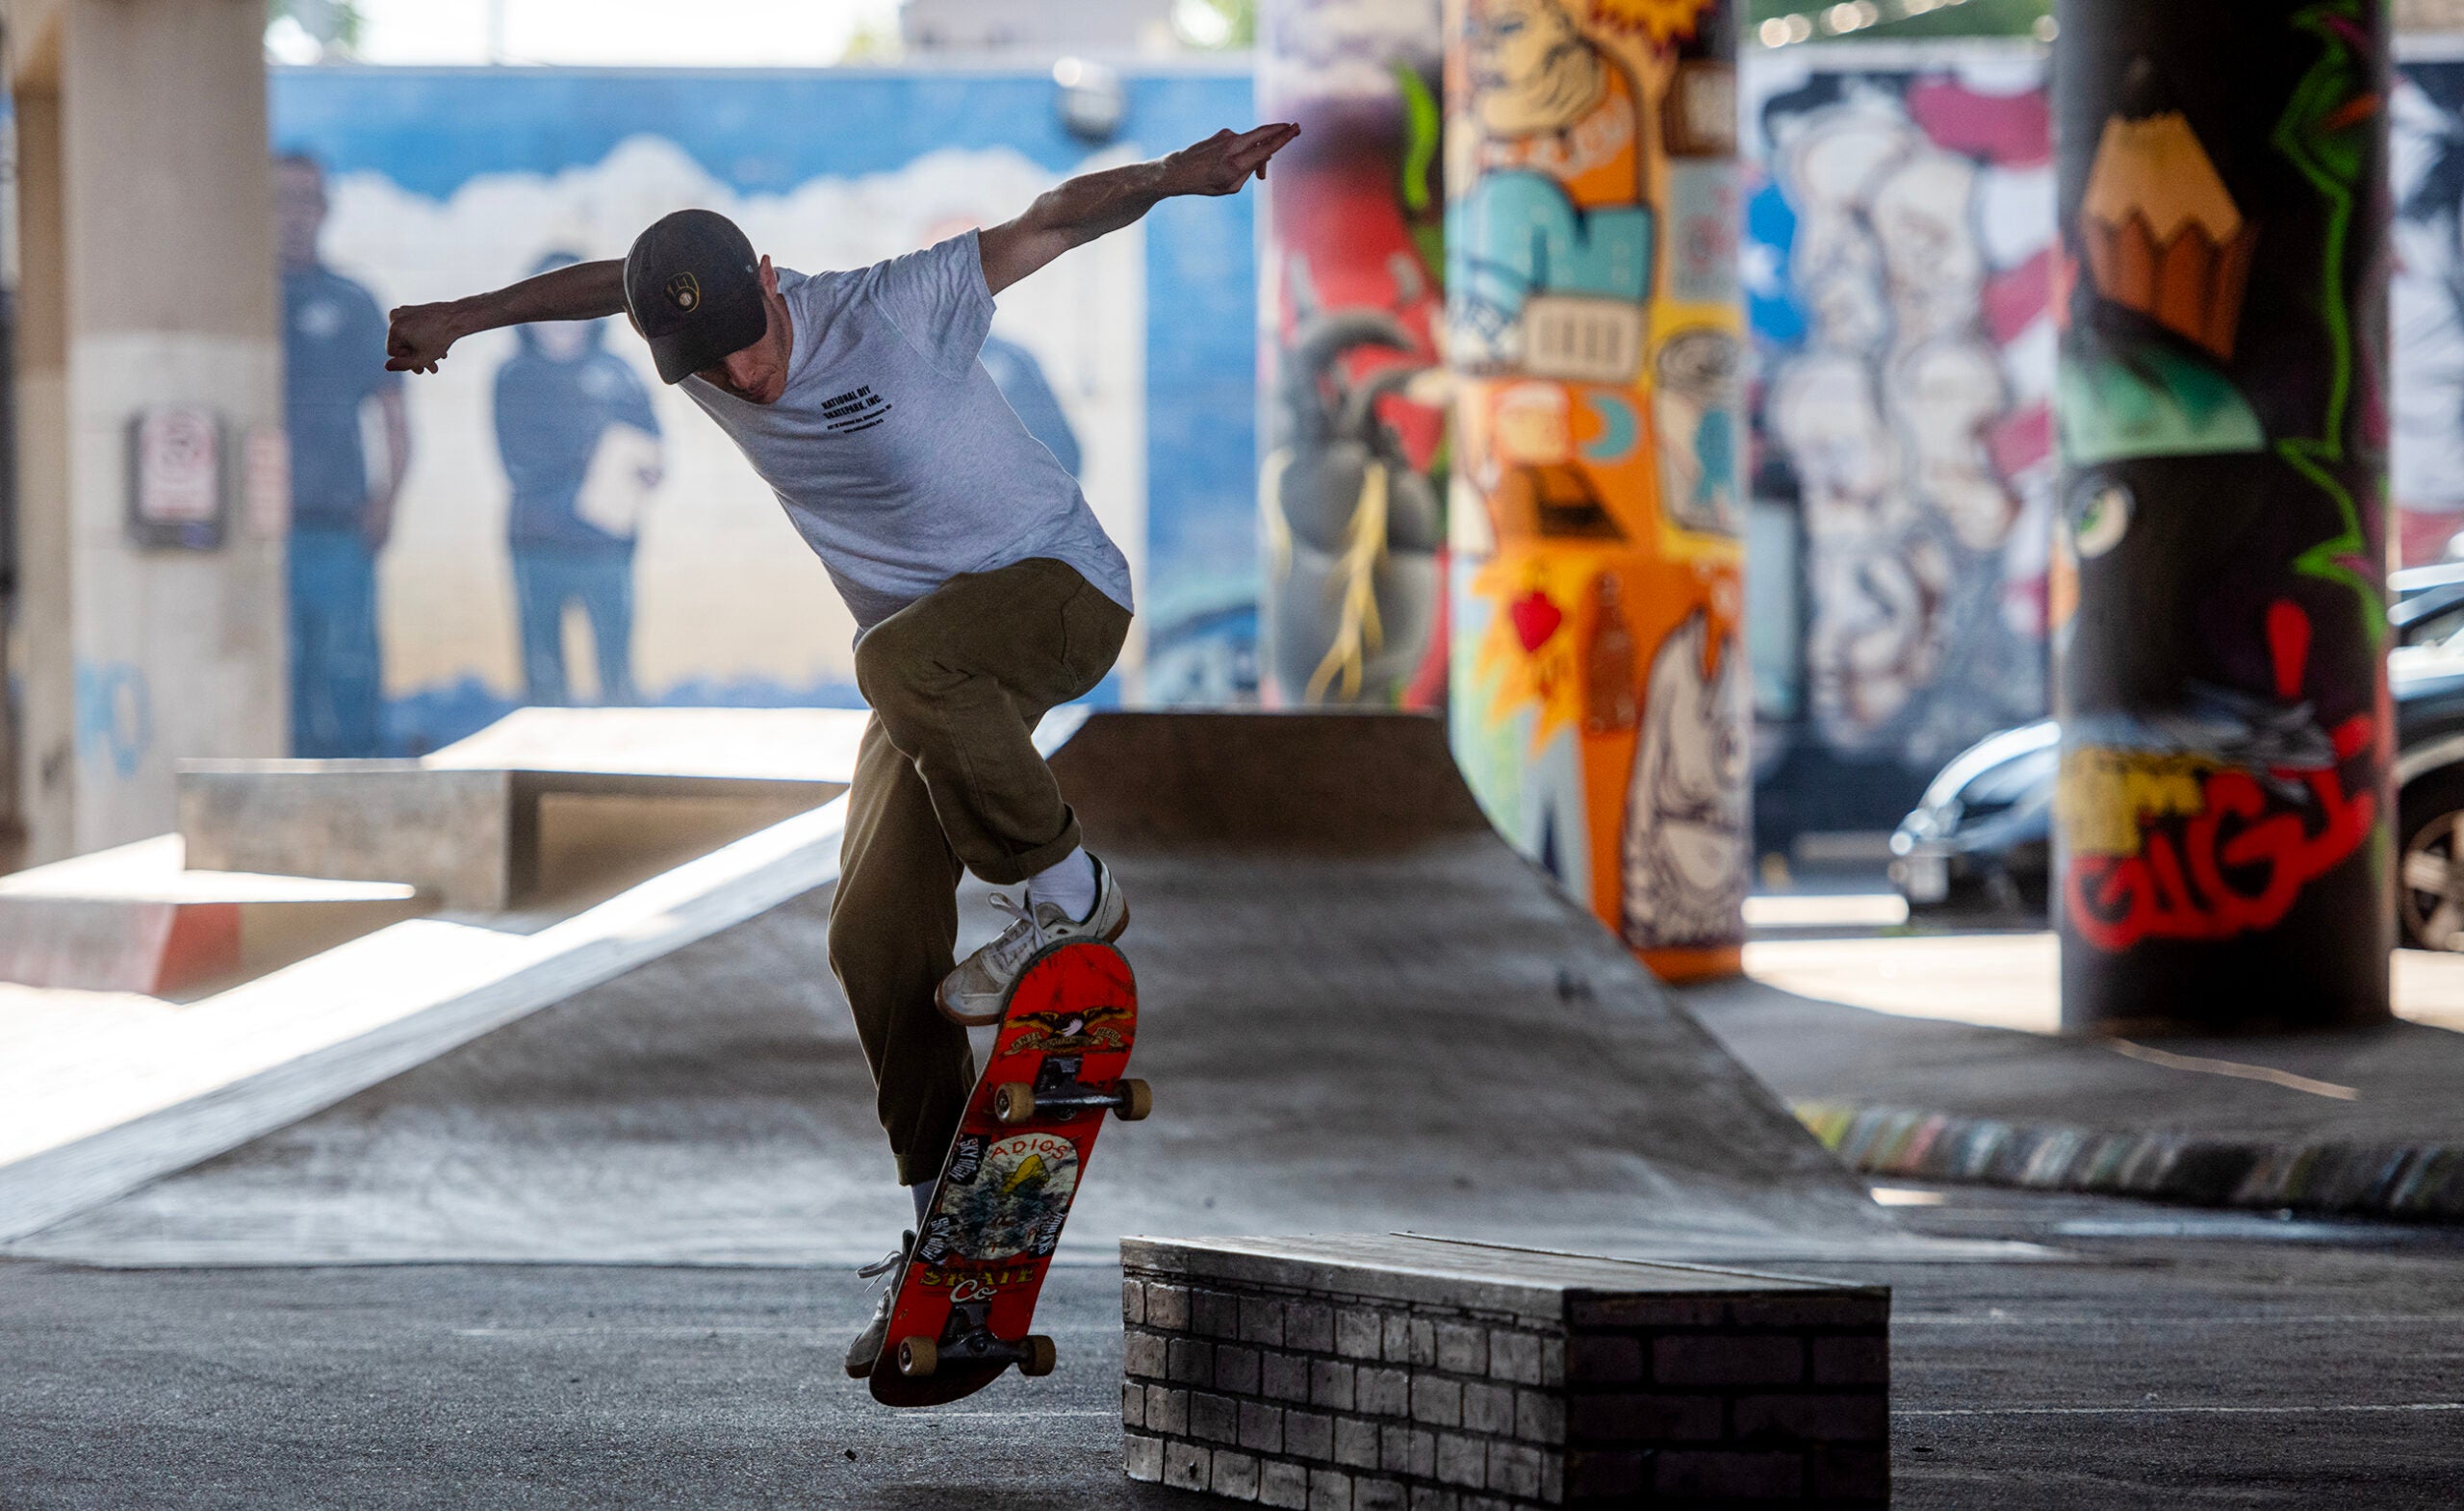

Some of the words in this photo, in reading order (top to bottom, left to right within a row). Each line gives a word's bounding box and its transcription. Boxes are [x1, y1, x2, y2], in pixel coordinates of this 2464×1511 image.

[821, 391, 859, 410] NATIONAL
[857, 385, 871, 397] DIY
[990, 1139, 1068, 1160] ADIOS
[949, 1279, 998, 1302] Co.
